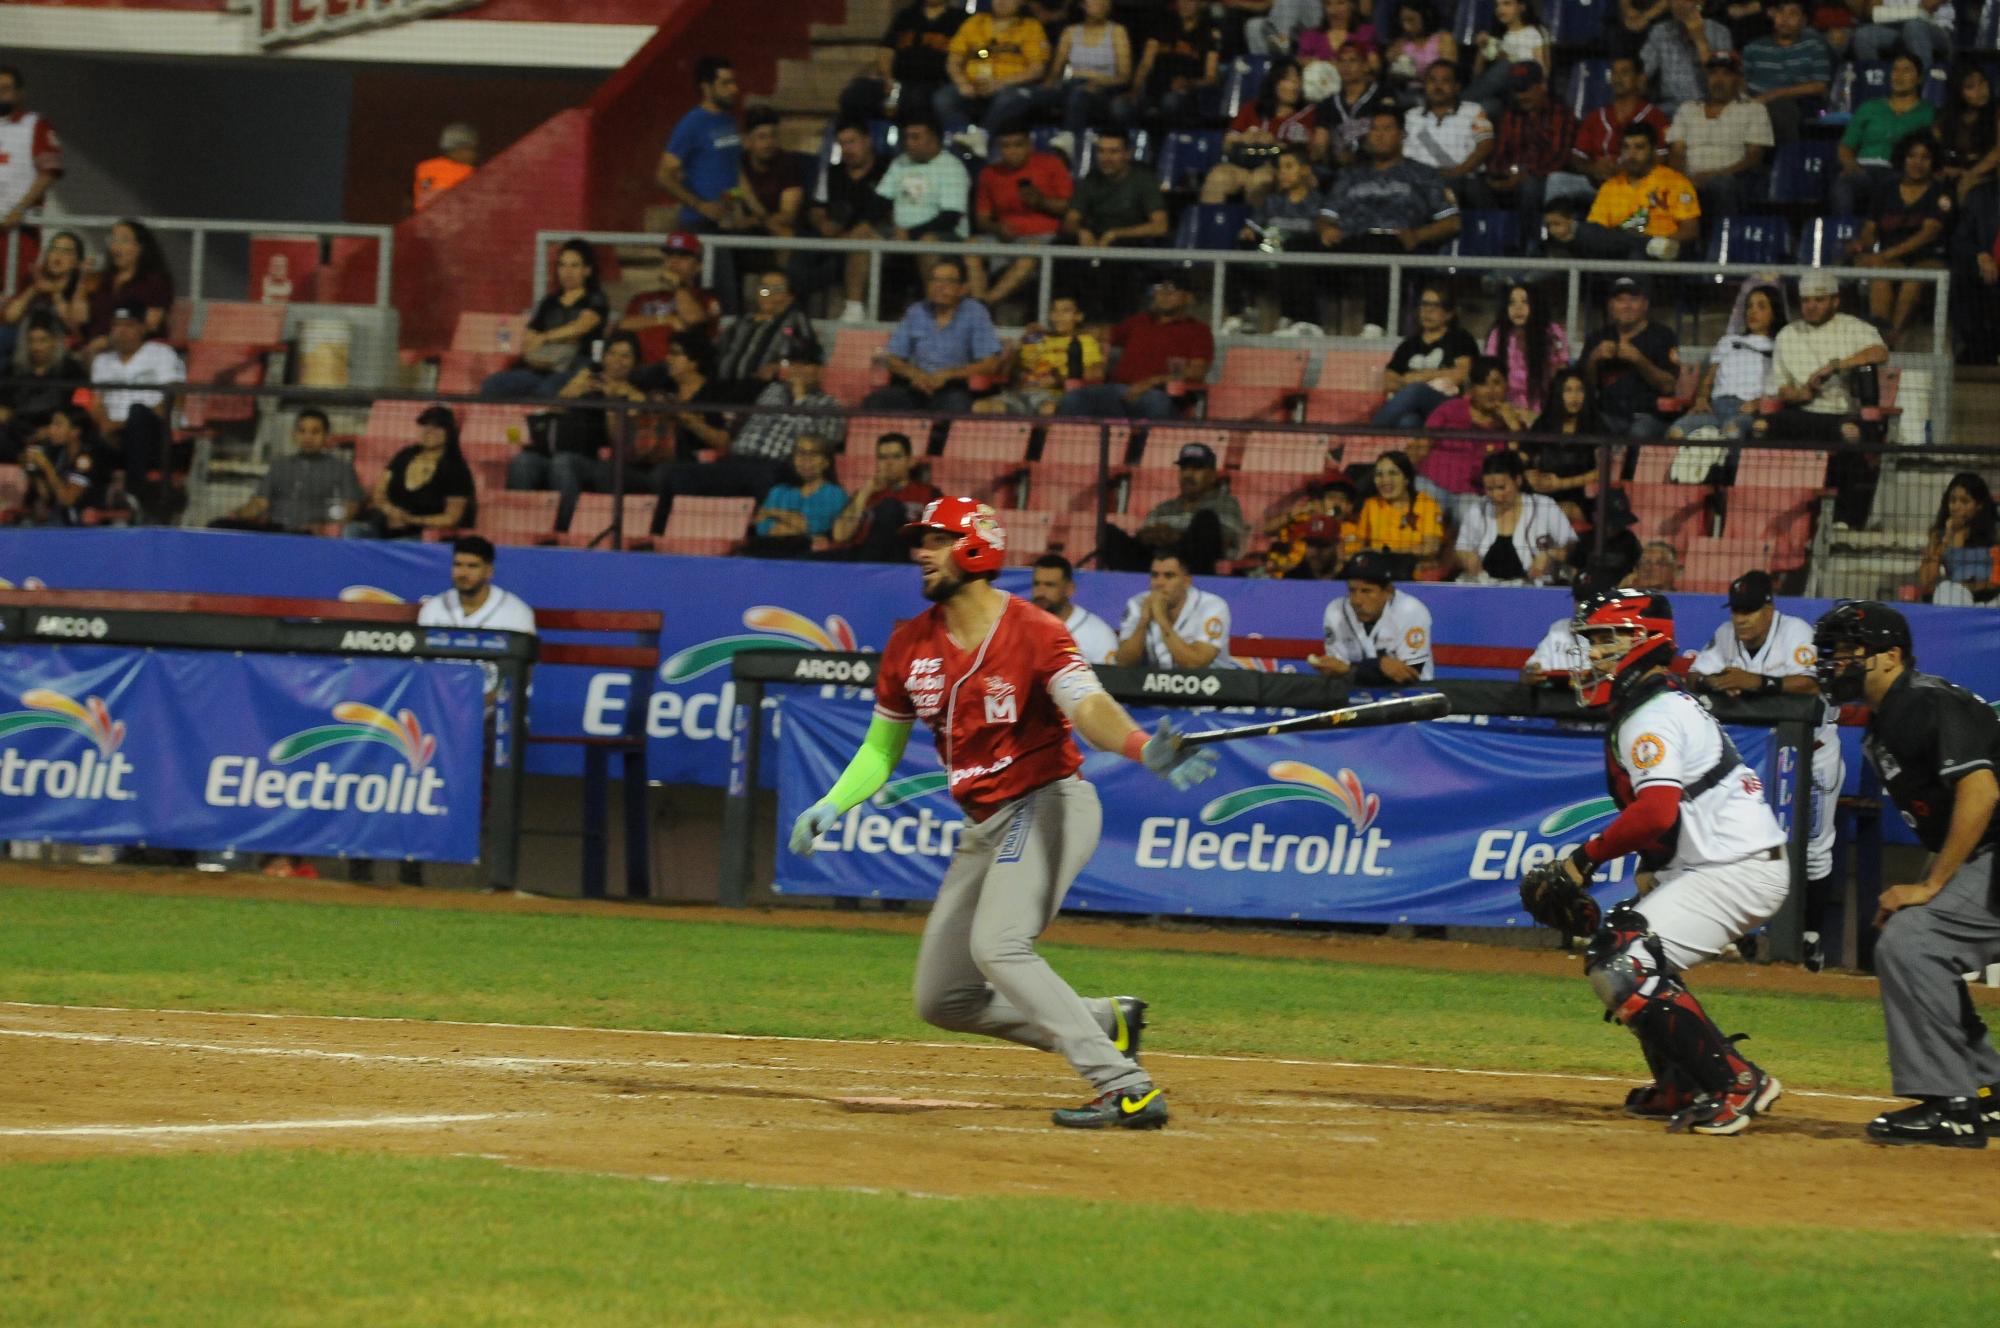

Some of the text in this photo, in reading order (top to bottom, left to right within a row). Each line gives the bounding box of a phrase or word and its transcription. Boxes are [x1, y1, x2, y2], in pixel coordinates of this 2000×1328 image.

[36, 615, 88, 638] ARCO
[341, 630, 395, 652] ARCO
[795, 658, 850, 681] ARCO
[1142, 672, 1200, 696] ARCO
[205, 755, 445, 816] Electrolit
[1135, 815, 1392, 877] Electrolit
